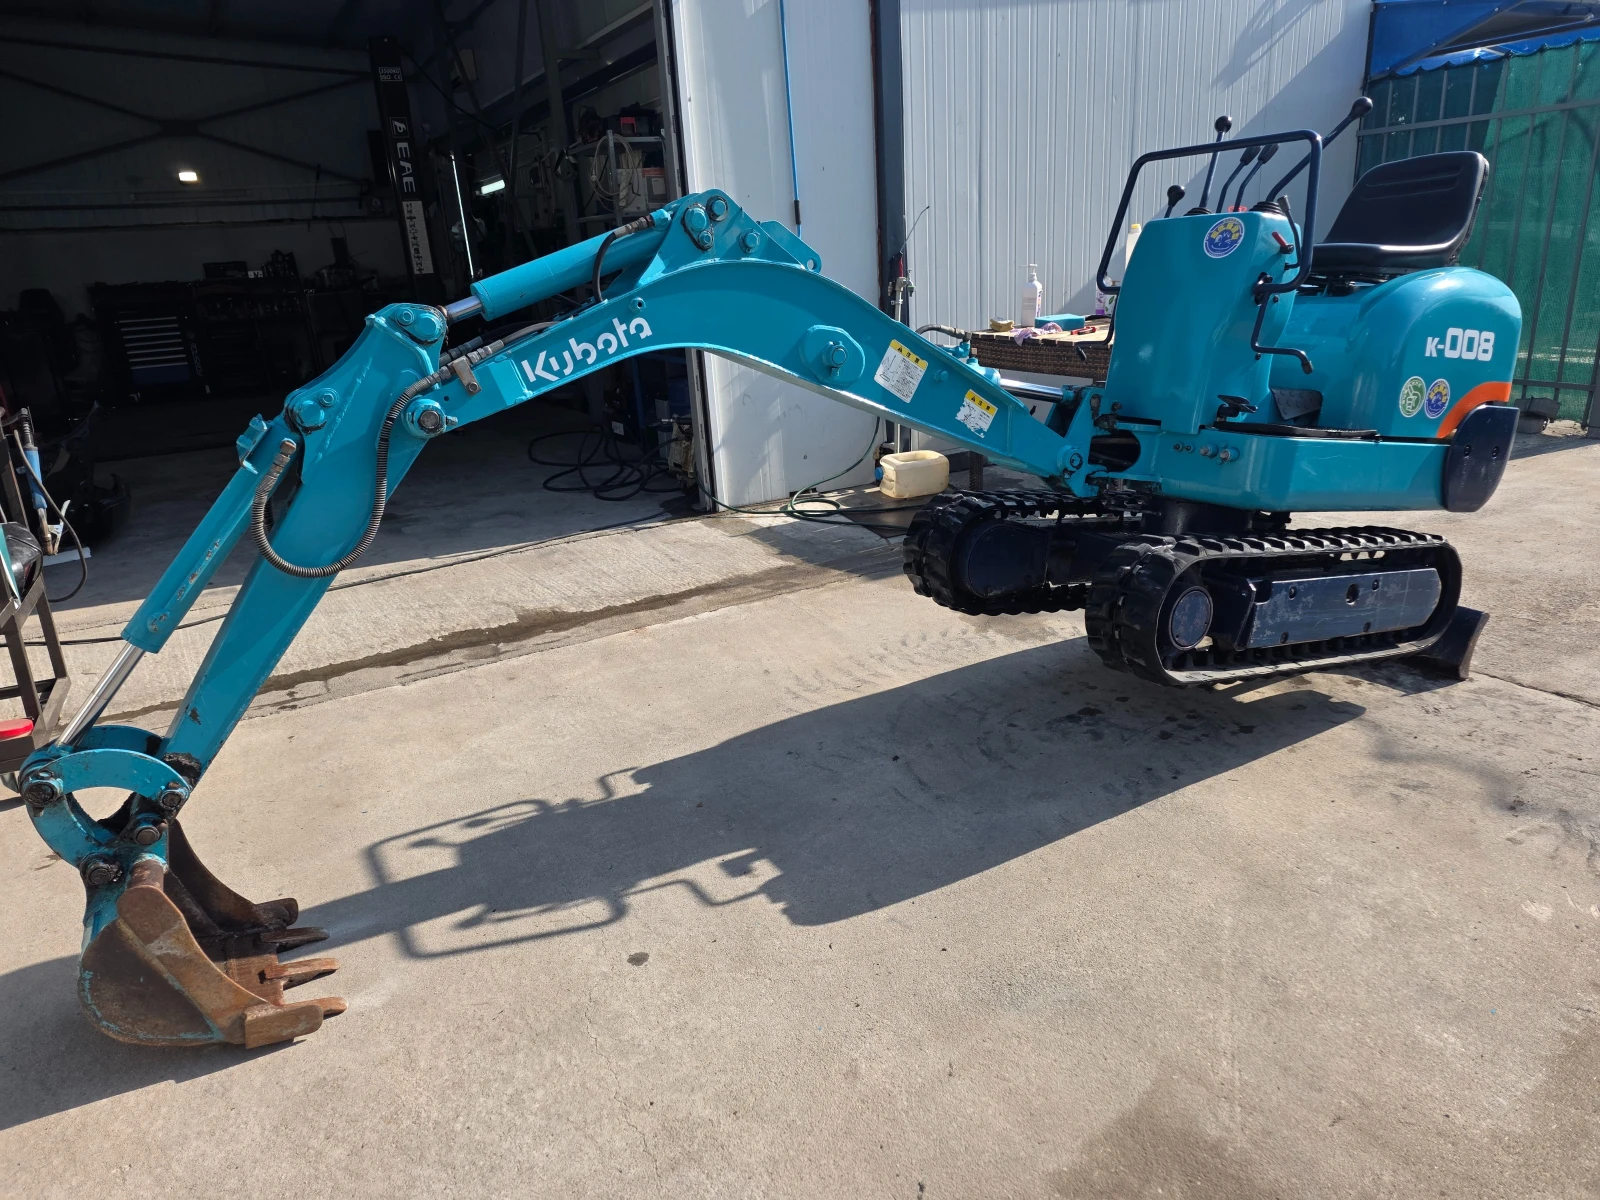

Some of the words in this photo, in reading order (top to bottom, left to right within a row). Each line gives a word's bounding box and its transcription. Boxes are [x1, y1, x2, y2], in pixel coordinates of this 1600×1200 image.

[396, 142, 416, 193] EAE
[521, 317, 653, 383] Kubota
[1425, 327, 1495, 361] K-008
